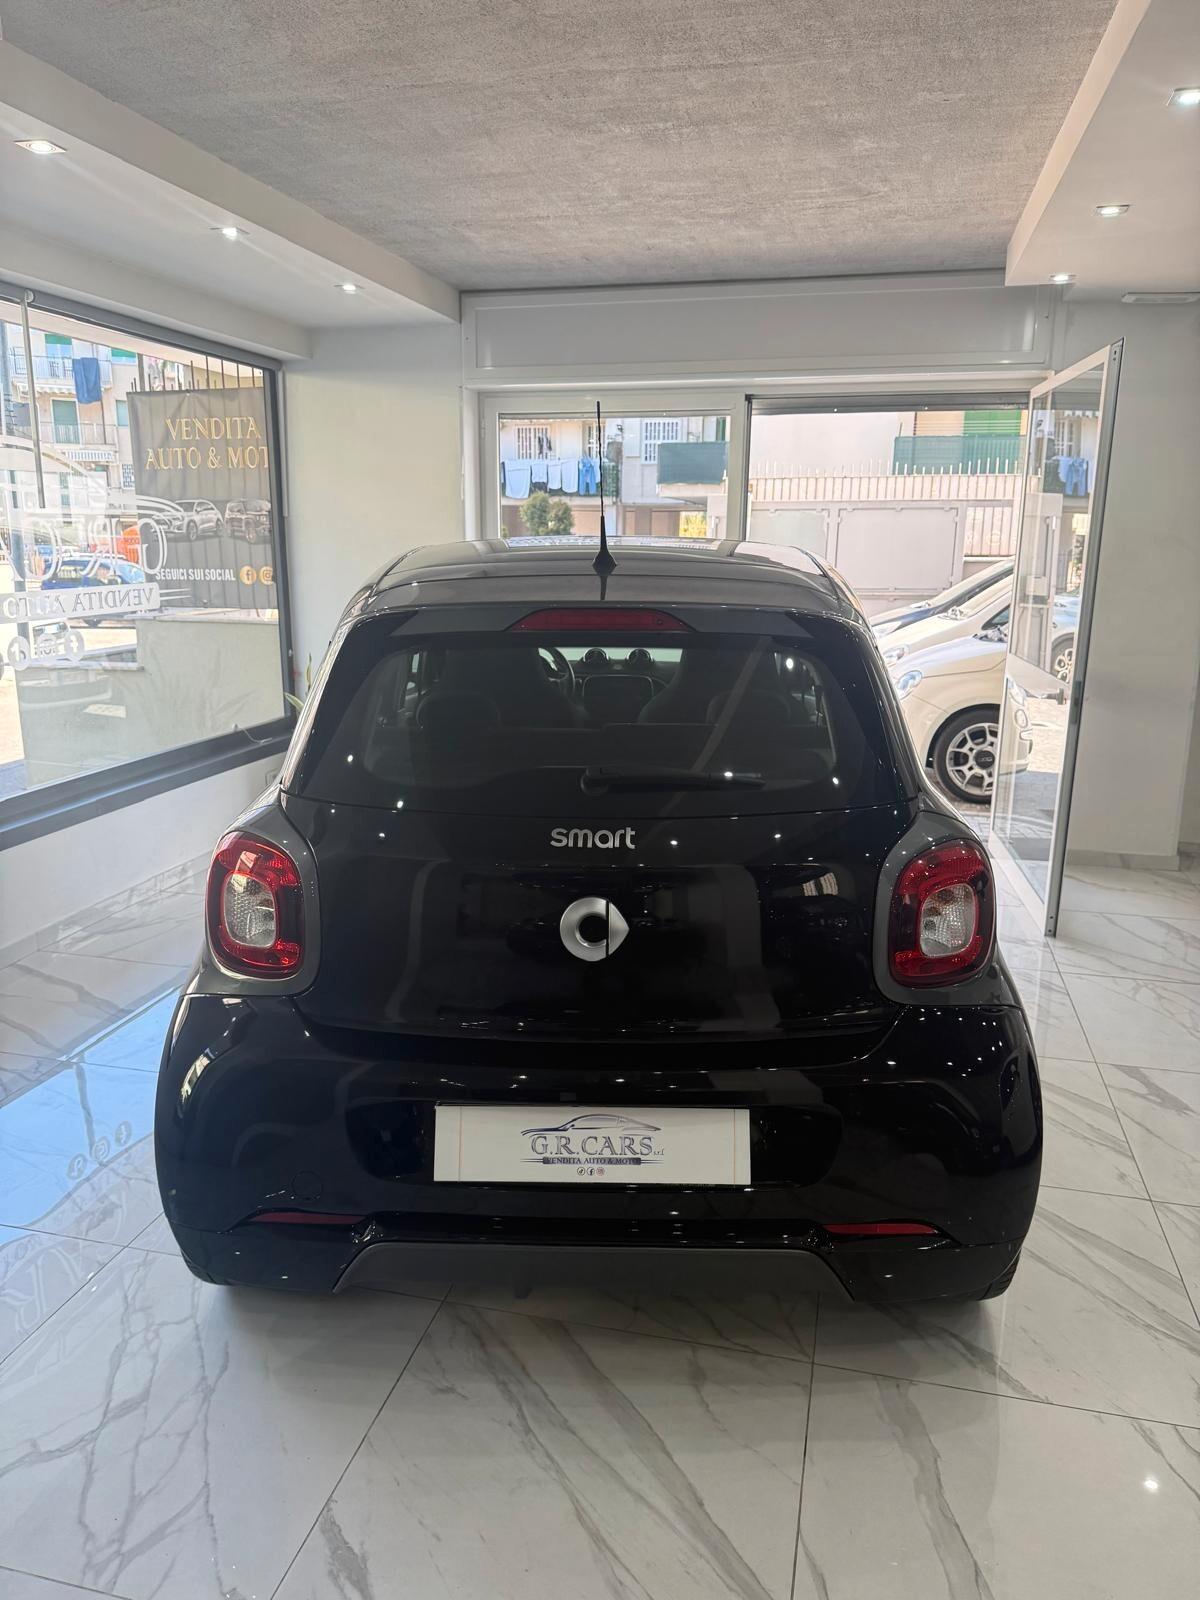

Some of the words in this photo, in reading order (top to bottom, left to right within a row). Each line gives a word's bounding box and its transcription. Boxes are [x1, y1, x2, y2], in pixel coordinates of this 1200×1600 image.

[166, 416, 262, 440] VENDITA
[146, 447, 201, 470] AUTO
[207, 447, 223, 469] &
[228, 446, 270, 470] MOT
[155, 569, 187, 581] SEGUICI
[188, 568, 204, 580] SUI
[205, 568, 236, 581] SOCIAL
[550, 827, 636, 849] smart
[584, 1157, 606, 1165] AUTO
